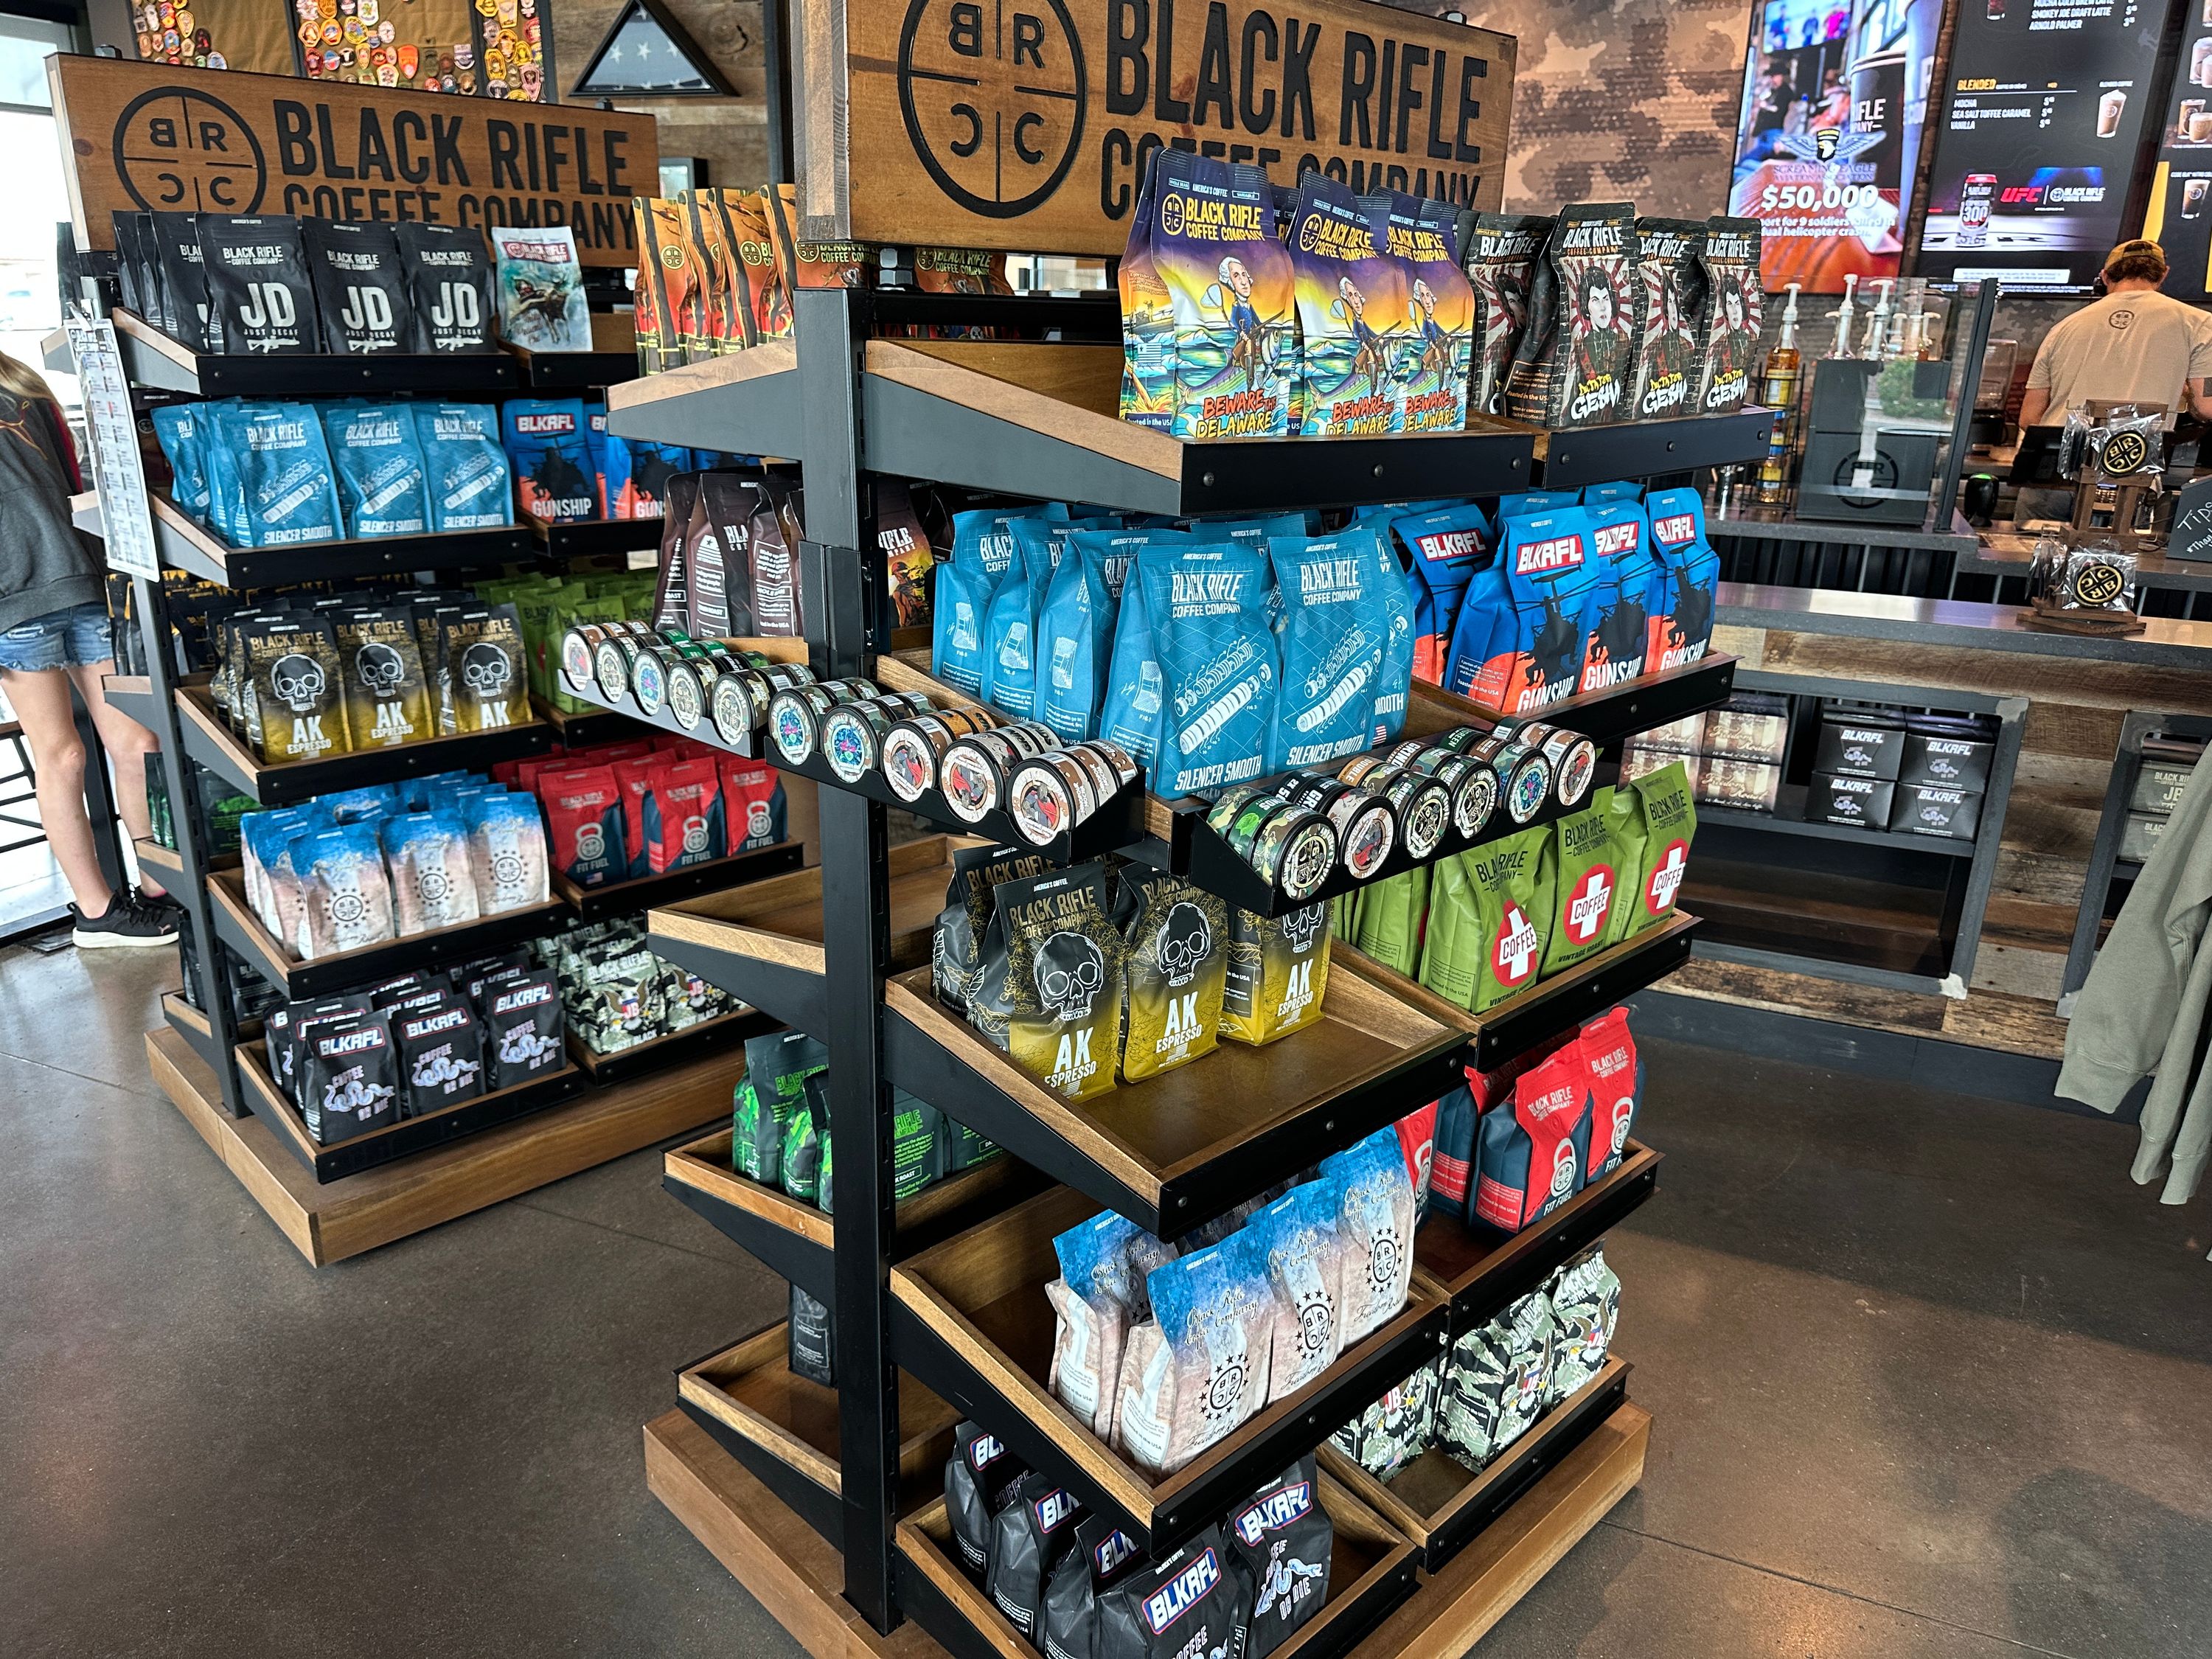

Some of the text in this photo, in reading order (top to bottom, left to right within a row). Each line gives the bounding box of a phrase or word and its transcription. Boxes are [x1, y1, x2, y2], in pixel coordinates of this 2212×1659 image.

[1105, 0, 1488, 164] BLACK RIFLE
[1957, 79, 1997, 91] BLENDED
[274, 99, 633, 197] BLACK RIFLE
[1761, 184, 1879, 212] $50,000
[2000, 187, 2042, 203] UFC
[1186, 198, 1262, 229] BLACK RIFLE
[1186, 224, 1265, 241] COFFEE COMPANY
[1320, 218, 1373, 249] BLACK RIFLE
[1388, 225, 1446, 251] BLACK RIFLE
[1562, 226, 1623, 248] BLACK RIFLE
[1784, 226, 1838, 237] helicopter
[223, 246, 283, 259] BLACK RIFLE
[327, 250, 379, 265] BLACK RIFLE
[421, 251, 473, 262] BLACK RIFLE
[1315, 242, 1379, 262] COFFEE COMPANY
[1393, 243, 1450, 262] COFFEE COMPANY
[1706, 238, 1752, 258] BLACK RIFLE
[239, 282, 296, 327] JD
[341, 285, 394, 330] JD
[431, 282, 480, 329] JD
[1203, 389, 1265, 420] BEWARE
[1332, 394, 1385, 422] BEWARE
[1404, 389, 1450, 415] BEWARE
[518, 414, 574, 431] BLKRFL
[1195, 411, 1273, 438] DELAWARE
[531, 498, 592, 517] GUNSHIP
[263, 525, 333, 544] SILENCER SMOOTH
[1419, 530, 1486, 561] BLKRFL
[1517, 538, 1582, 573] BLKRFL
[1171, 574, 1244, 603] BLACK RIFLE
[1300, 560, 1359, 592] BLACK RIFLE
[1172, 603, 1241, 618] COFFEE COMPANY
[1303, 589, 1362, 606] COFFEE COMPANY
[778, 621, 790, 629] USA
[251, 632, 325, 650] BLACK RIFLE
[1584, 655, 1643, 690] GUNSHIP
[376, 701, 406, 728] AK
[481, 701, 510, 728] AK
[293, 715, 325, 742] AK
[371, 724, 414, 739] ESPRESSO
[1840, 729, 1884, 744] BLKRFL
[287, 739, 332, 754] ESPRESSO
[1286, 733, 1366, 766] SILENCER SMOOTH
[1927, 741, 1972, 756] BLKRFL
[1174, 754, 1263, 791] SILENCER SMOOTH
[2154, 771, 2177, 782] BLACK
[1830, 779, 1874, 793] BLKRFL
[1917, 789, 1962, 804] BLKRFL
[746, 835, 775, 849] FIT FUEL
[1565, 822, 1589, 848] BLACK
[577, 858, 610, 873] FIT FUEL
[681, 850, 712, 866] FIT FUEL
[1498, 850, 1529, 873] RIFLE
[1009, 886, 1096, 928] BLACK RIFLE
[1573, 889, 1608, 920] COFFEE
[1502, 926, 1536, 960] COFFEE
[1558, 947, 1585, 964] VINTAGE
[1285, 959, 1314, 1001] AK
[494, 984, 552, 1012] BLKRFL
[623, 1004, 639, 1018] JB
[1277, 990, 1314, 1017] ESPRESSO
[406, 1011, 468, 1037] BLKRFL
[1164, 991, 1199, 1037] AK
[319, 1029, 383, 1055] BLKRFL
[1054, 1027, 1094, 1074] AK
[1155, 1023, 1203, 1054] ESPRESSO
[1044, 1061, 1097, 1088] ESPRESSO
[1591, 1054, 1613, 1074] BLACK
[1527, 1085, 1573, 1117] BLACK RIFLE
[1605, 1156, 1618, 1173] FIT
[1543, 1189, 1573, 1216] FIT FUEL
[1523, 1374, 1540, 1394] JB
[1384, 1386, 1400, 1411] JB
[1242, 1485, 1311, 1543] BLKRFL
[1151, 1552, 1220, 1630] BLKRFL
[1292, 1575, 1312, 1606] DIE
